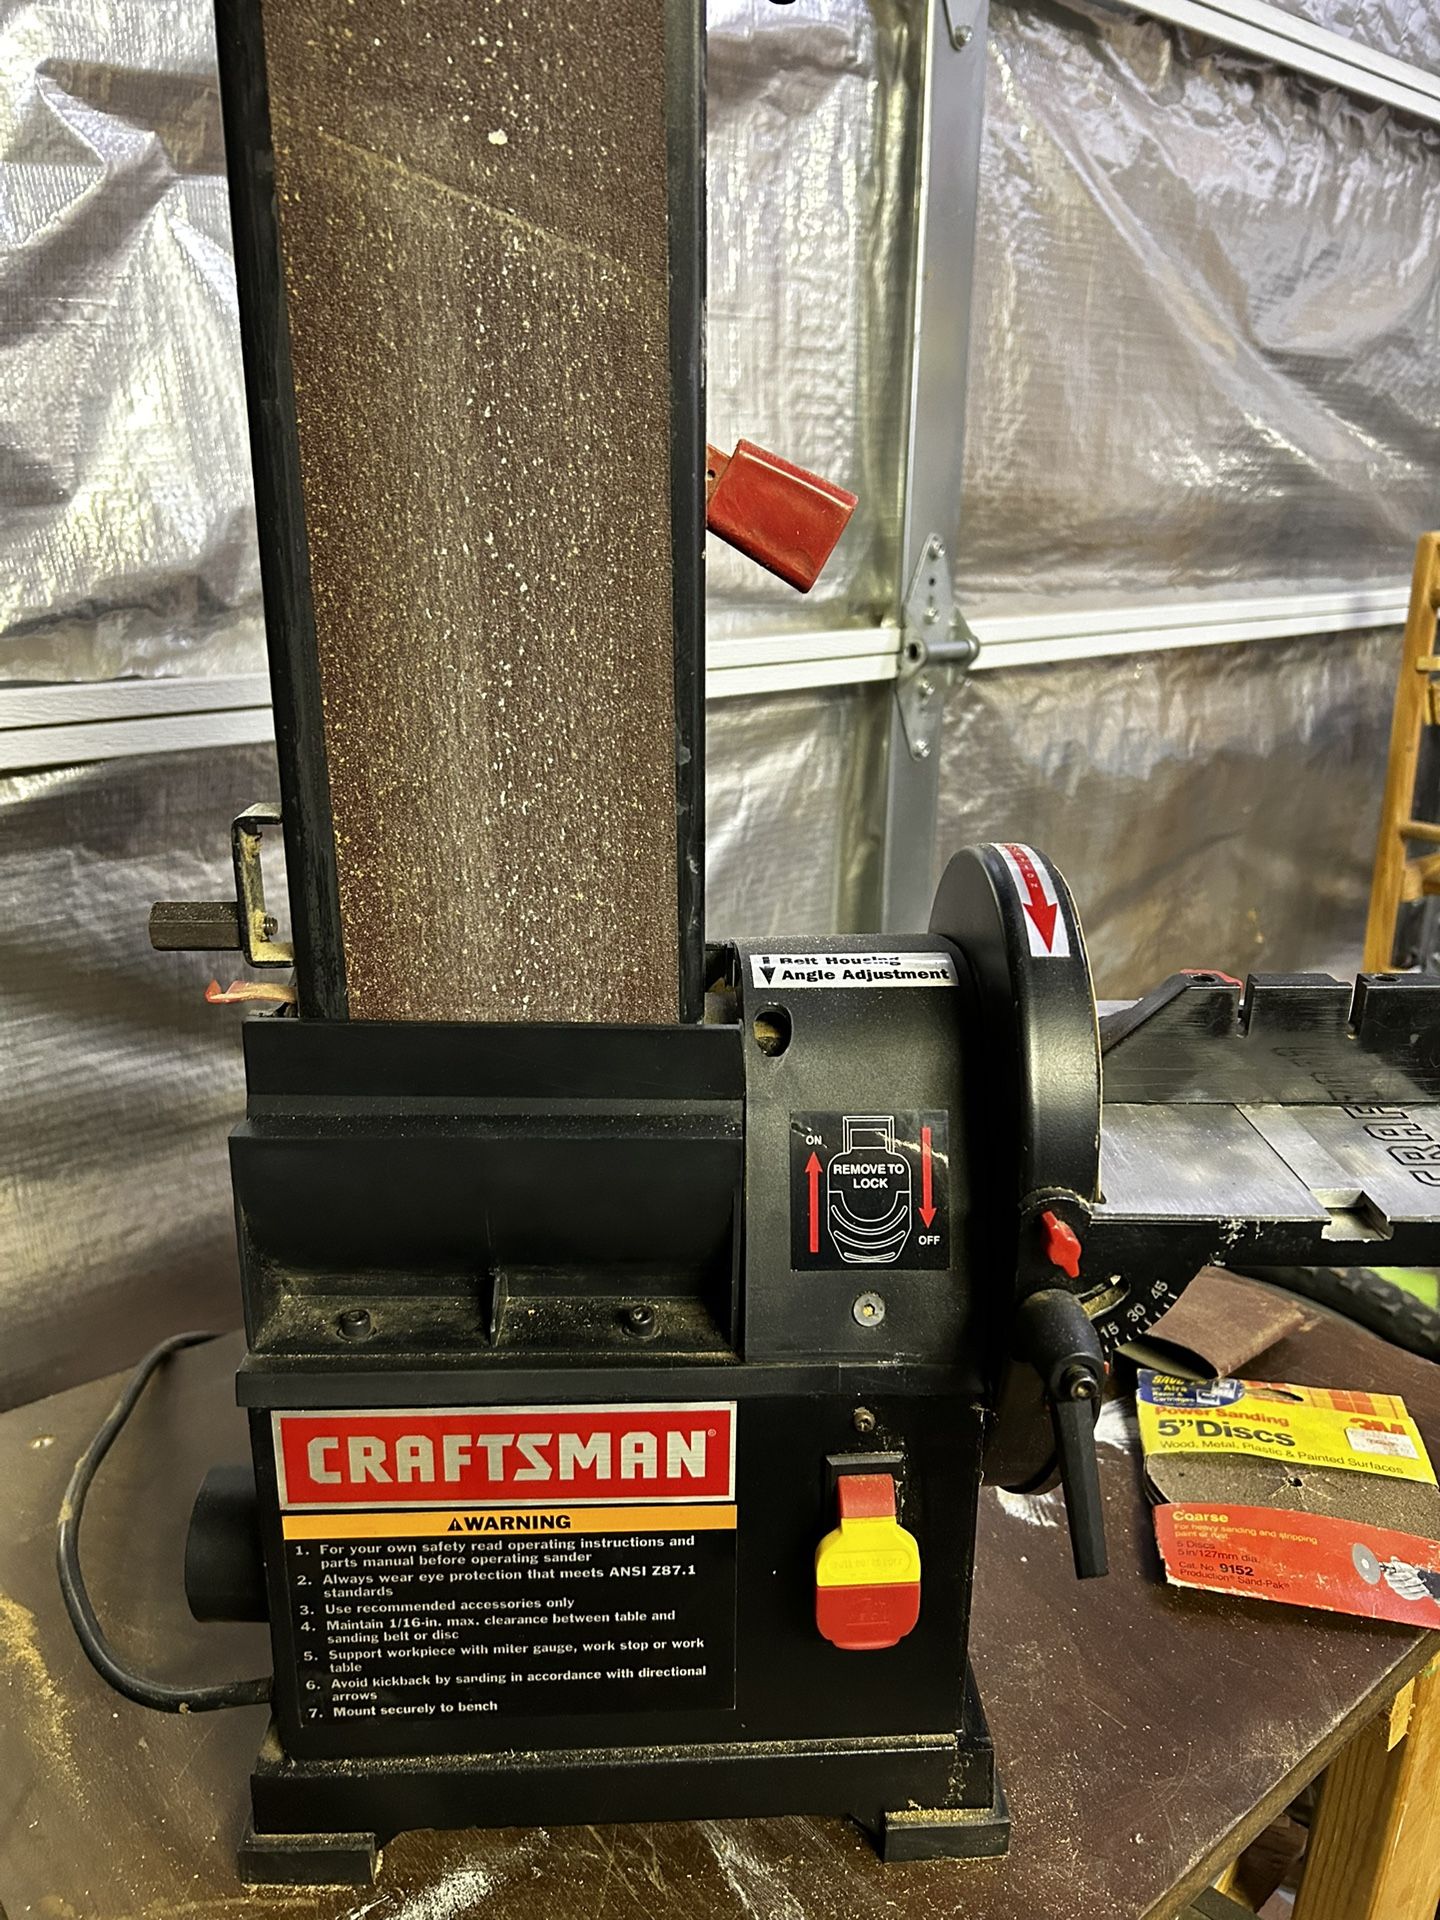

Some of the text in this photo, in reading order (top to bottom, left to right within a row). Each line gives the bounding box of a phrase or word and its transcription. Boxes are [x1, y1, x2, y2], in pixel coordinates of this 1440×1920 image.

[781, 967, 951, 982] Angle Adjustment
[805, 1135, 822, 1146] ON
[832, 1163, 905, 1175] REMOVE TO
[852, 1177, 889, 1189] LOCK
[918, 1235, 940, 1246] OFF
[1150, 1280, 1168, 1299] 45
[1126, 1303, 1146, 1322] 30
[1100, 1321, 1120, 1339] 15
[1155, 1406, 1290, 1427] Power Sanding
[1350, 1417, 1407, 1435] 3M
[1159, 1440, 1404, 1474] Wood, Metal, Plastic & Painted Surfaces
[463, 1513, 572, 1531] WARNING
[1172, 1510, 1229, 1523] Coarse
[1186, 1540, 1216, 1549] Discs
[1220, 1526, 1257, 1536] sanding
[1259, 1529, 1276, 1537] and
[1279, 1532, 1318, 1545] stripping
[295, 1534, 695, 1556] 1. For your own safety read operating instructions and
[320, 1551, 593, 1571] parts manual before operating sander
[1241, 1553, 1261, 1563] dia.
[297, 1564, 696, 1586] 2. Always wear eye protection that meets ANSI Z87.1
[1219, 1563, 1255, 1577] 9152
[323, 1585, 394, 1599] standards
[299, 1596, 575, 1616] 3. Use recommended accessories only
[300, 1609, 676, 1632] 4. Maintain 1/16-in. max. clearance between table and
[327, 1629, 459, 1644] sanding belt or disc
[303, 1637, 705, 1662] 5. Support workpiece with miter gauge, work stop or work
[329, 1661, 362, 1673] table
[305, 1665, 707, 1690] 6. Avoid kickback by sanding in accordance with directional
[331, 1691, 378, 1702] arrows
[308, 1700, 498, 1719] 7. Mount securely to bench
